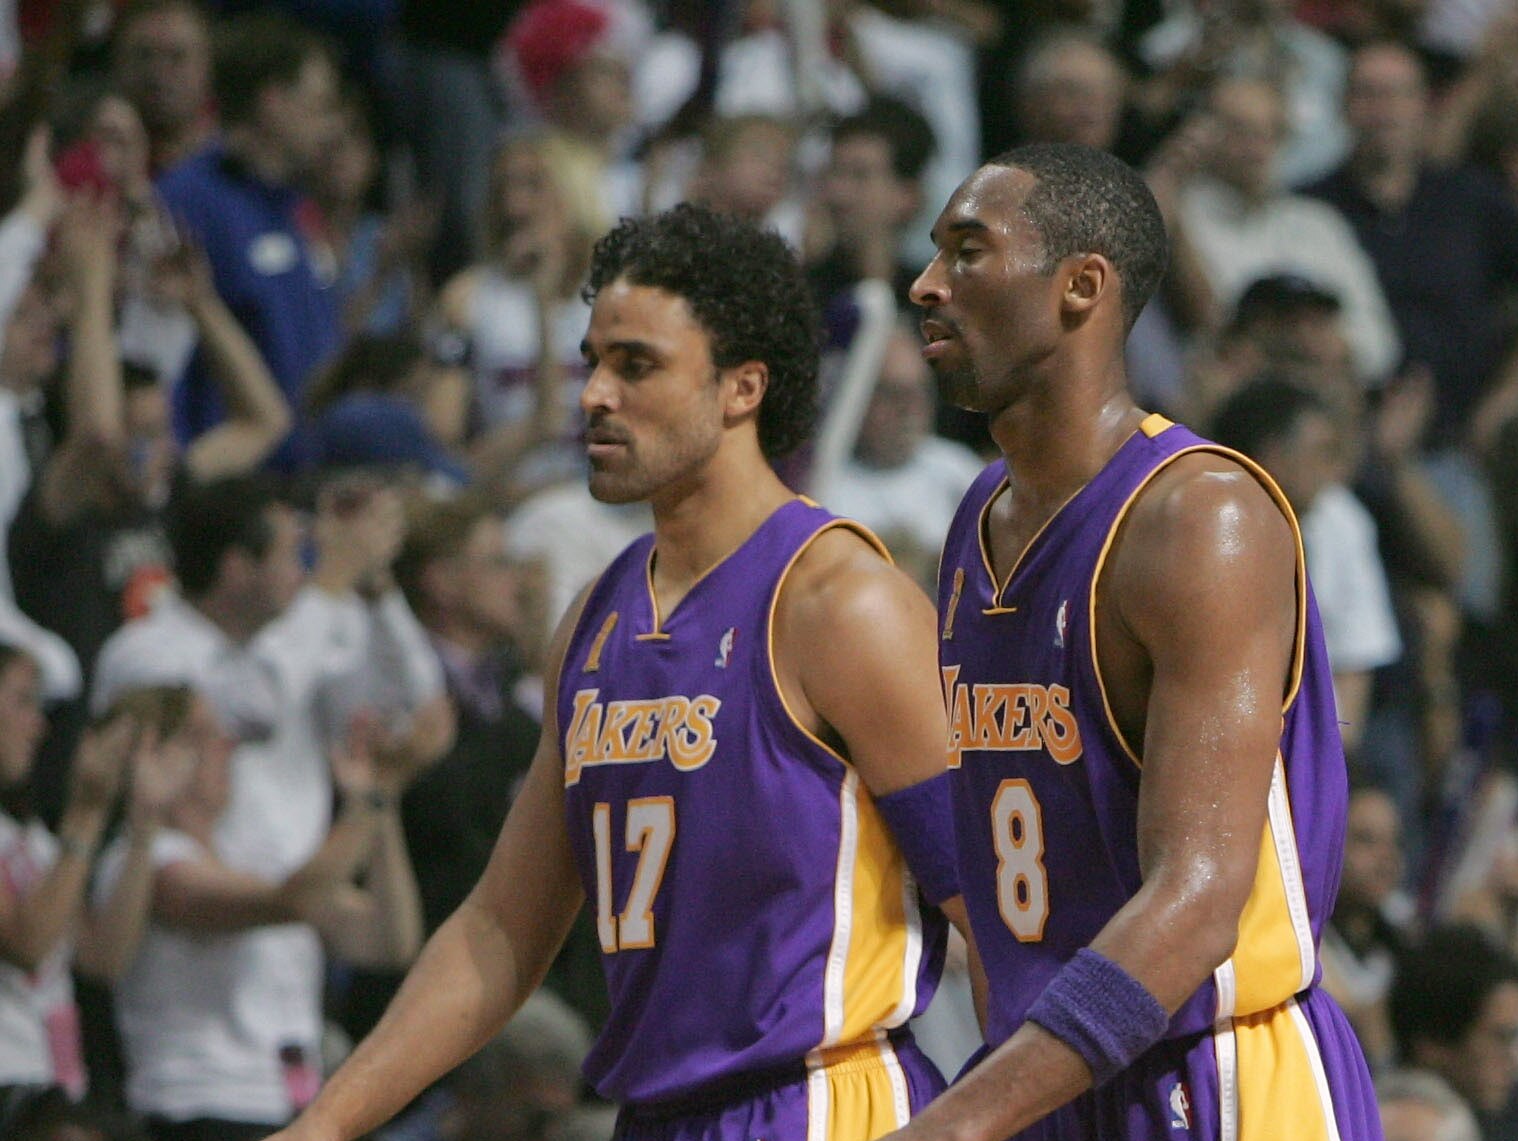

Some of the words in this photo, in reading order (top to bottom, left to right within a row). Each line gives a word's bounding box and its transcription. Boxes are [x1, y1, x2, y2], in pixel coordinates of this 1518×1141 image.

[565, 688, 721, 788] LAKERS
[942, 665, 1083, 769] LAKERS
[593, 795, 676, 954] 17
[991, 778, 1049, 942] 8
